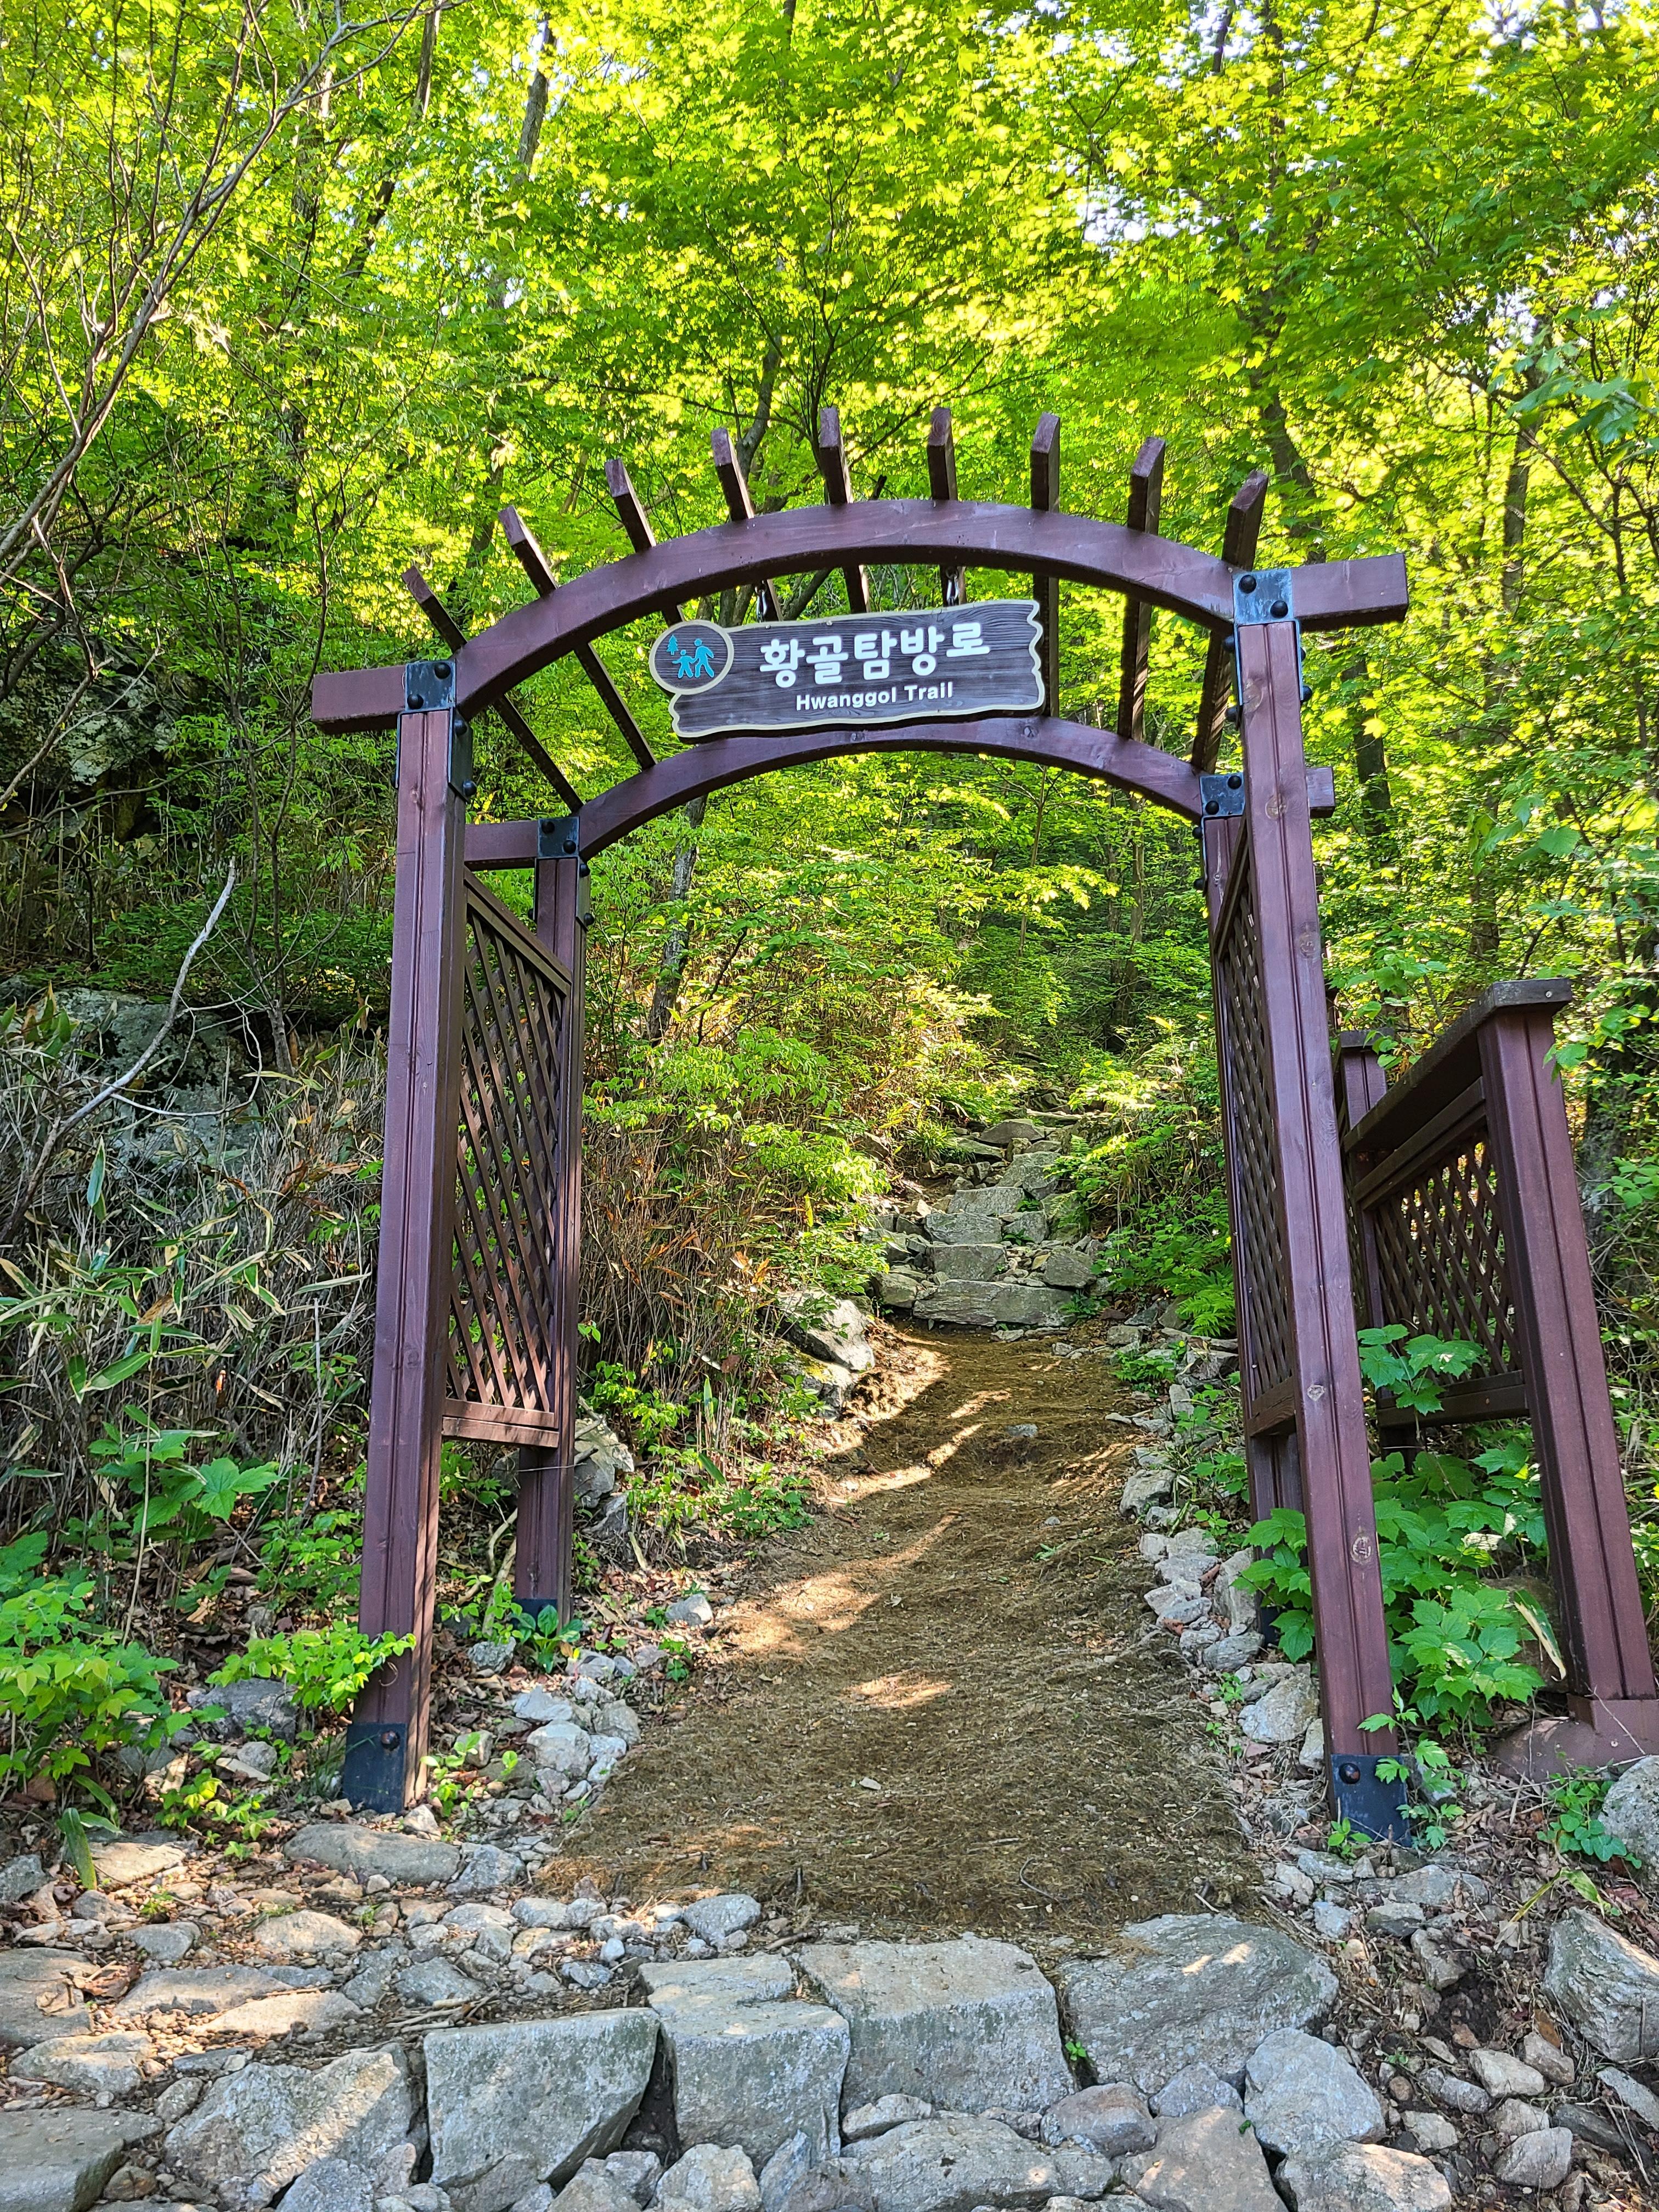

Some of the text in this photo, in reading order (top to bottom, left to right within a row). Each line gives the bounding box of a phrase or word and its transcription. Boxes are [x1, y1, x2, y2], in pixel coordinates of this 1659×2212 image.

[759, 622, 990, 688] 황골탐방로
[796, 681, 953, 711] Hwanggol Trail
